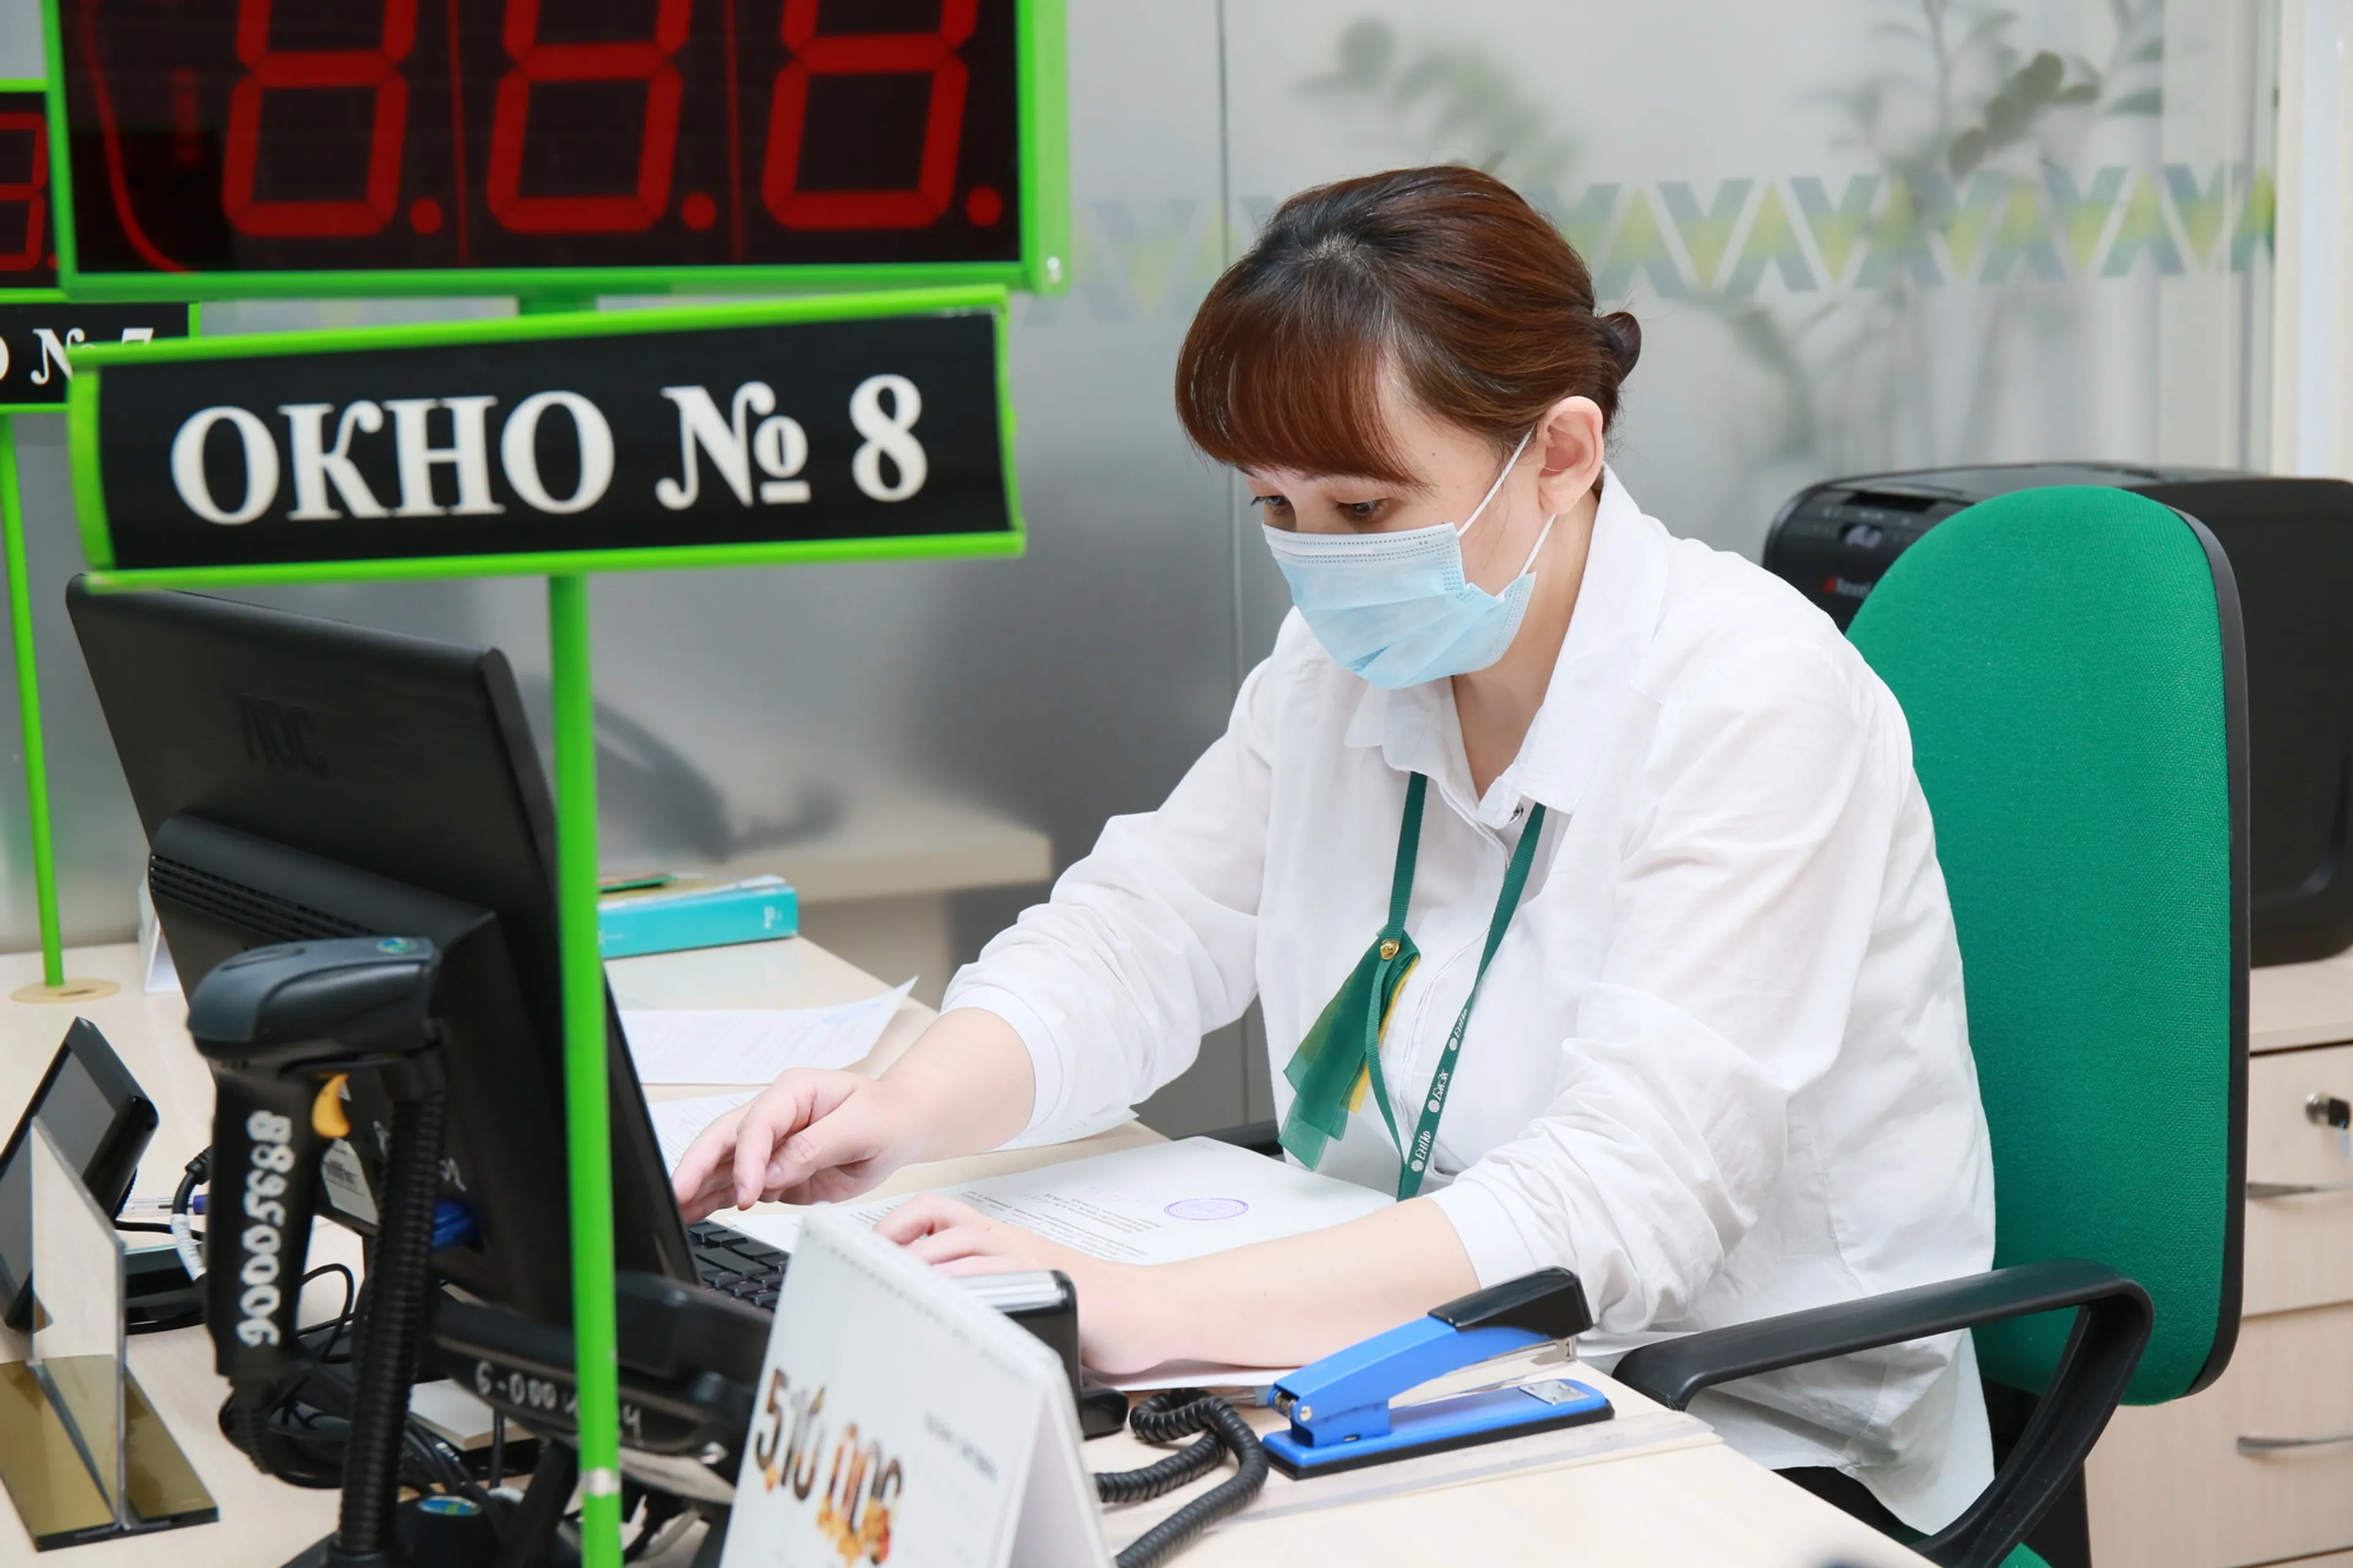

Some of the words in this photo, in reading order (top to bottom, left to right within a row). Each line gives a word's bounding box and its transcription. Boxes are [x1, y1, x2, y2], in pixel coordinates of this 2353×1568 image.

[172, 390, 615, 525] ОКНО
[656, 381, 811, 510] №
[849, 374, 928, 502] 8
